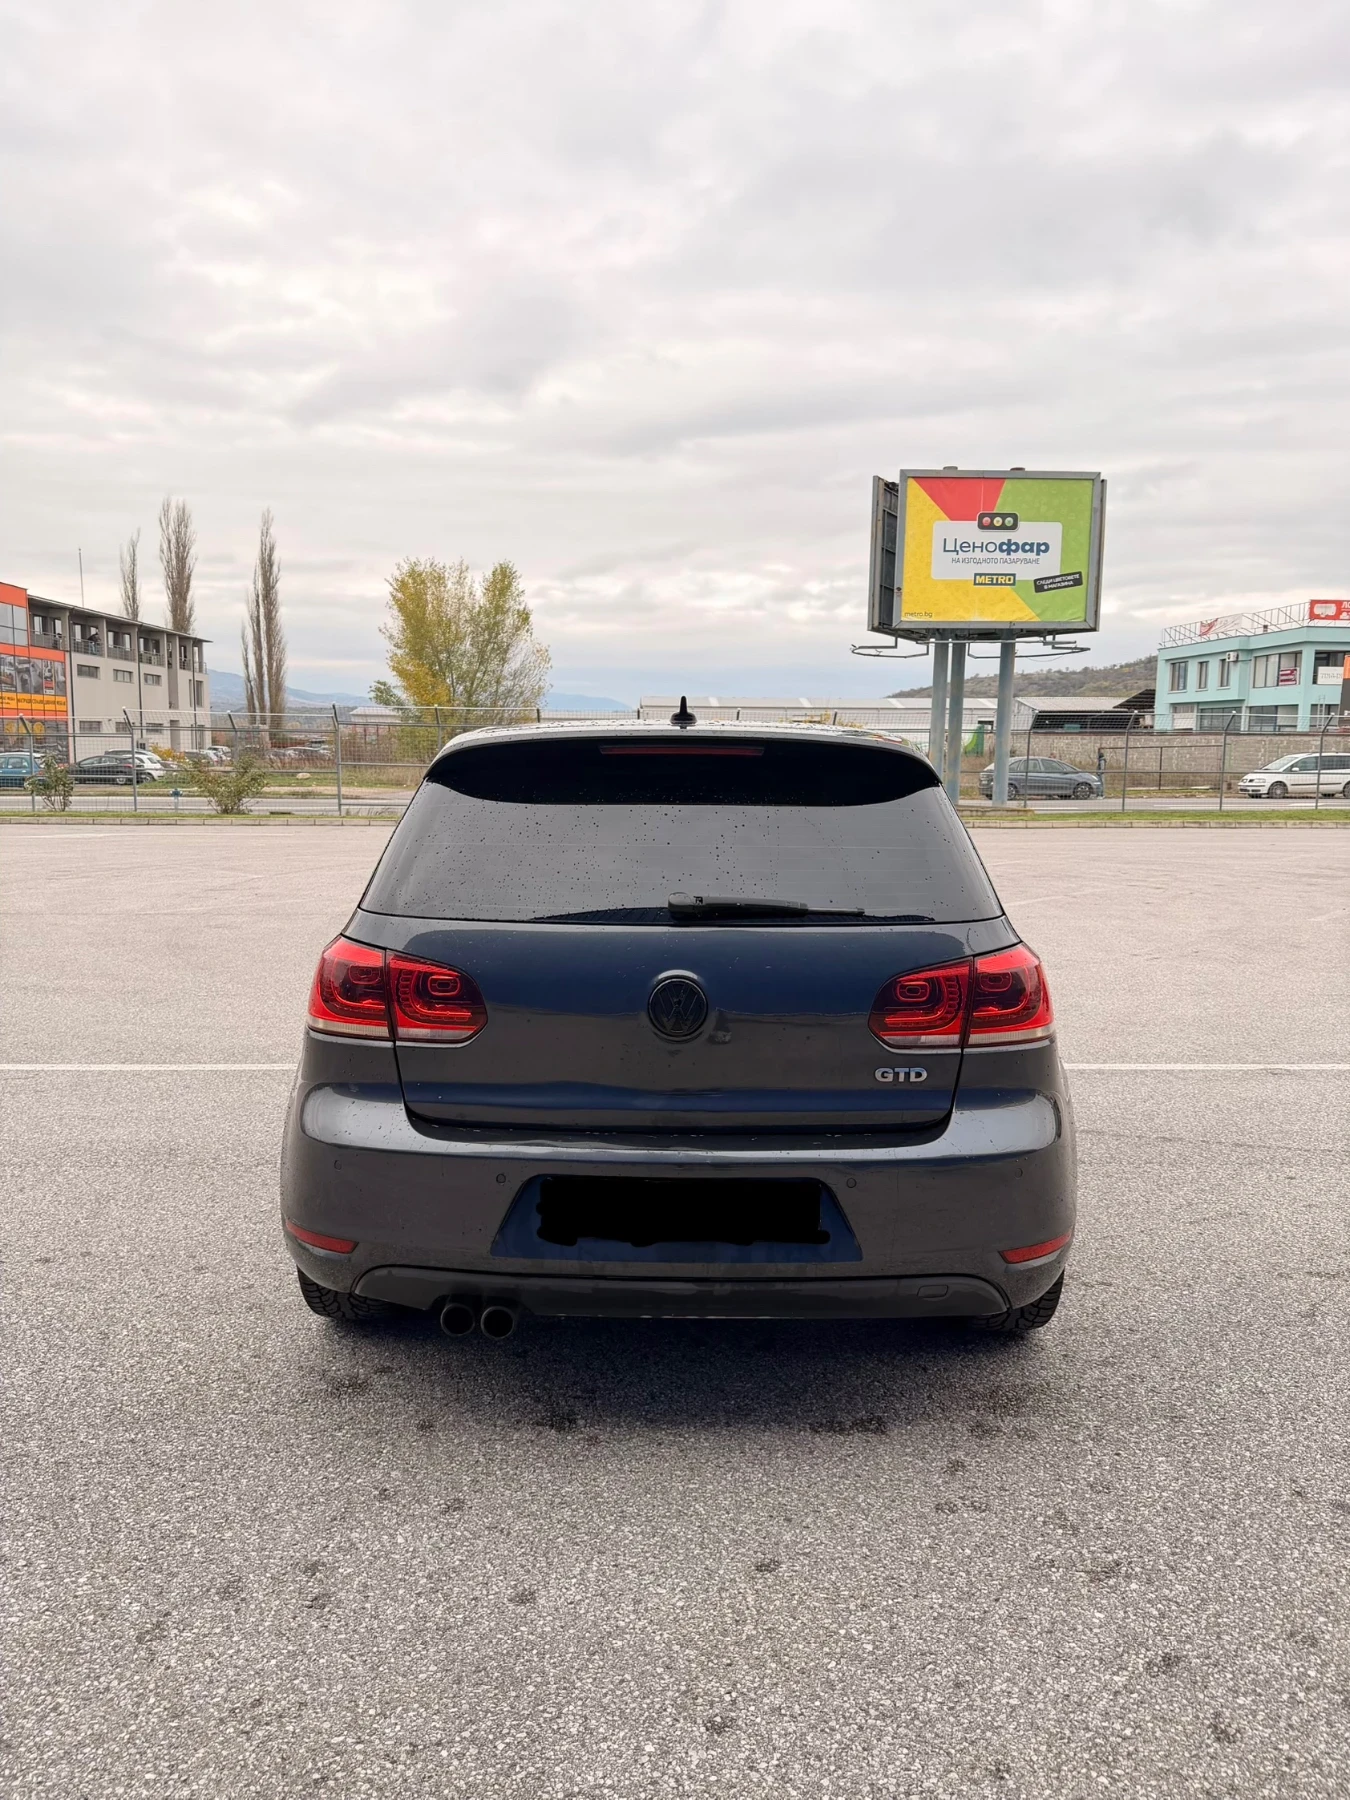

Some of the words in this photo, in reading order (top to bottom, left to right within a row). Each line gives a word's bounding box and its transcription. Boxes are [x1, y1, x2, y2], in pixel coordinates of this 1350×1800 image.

[943, 538, 1050, 556] Ценофар
[962, 557, 999, 565] ИЗГОДНОТО
[1000, 557, 1040, 565] ПАЗАРУВАНЕ
[975, 575, 1014, 584] METRO
[875, 1067, 928, 1082] GTD
